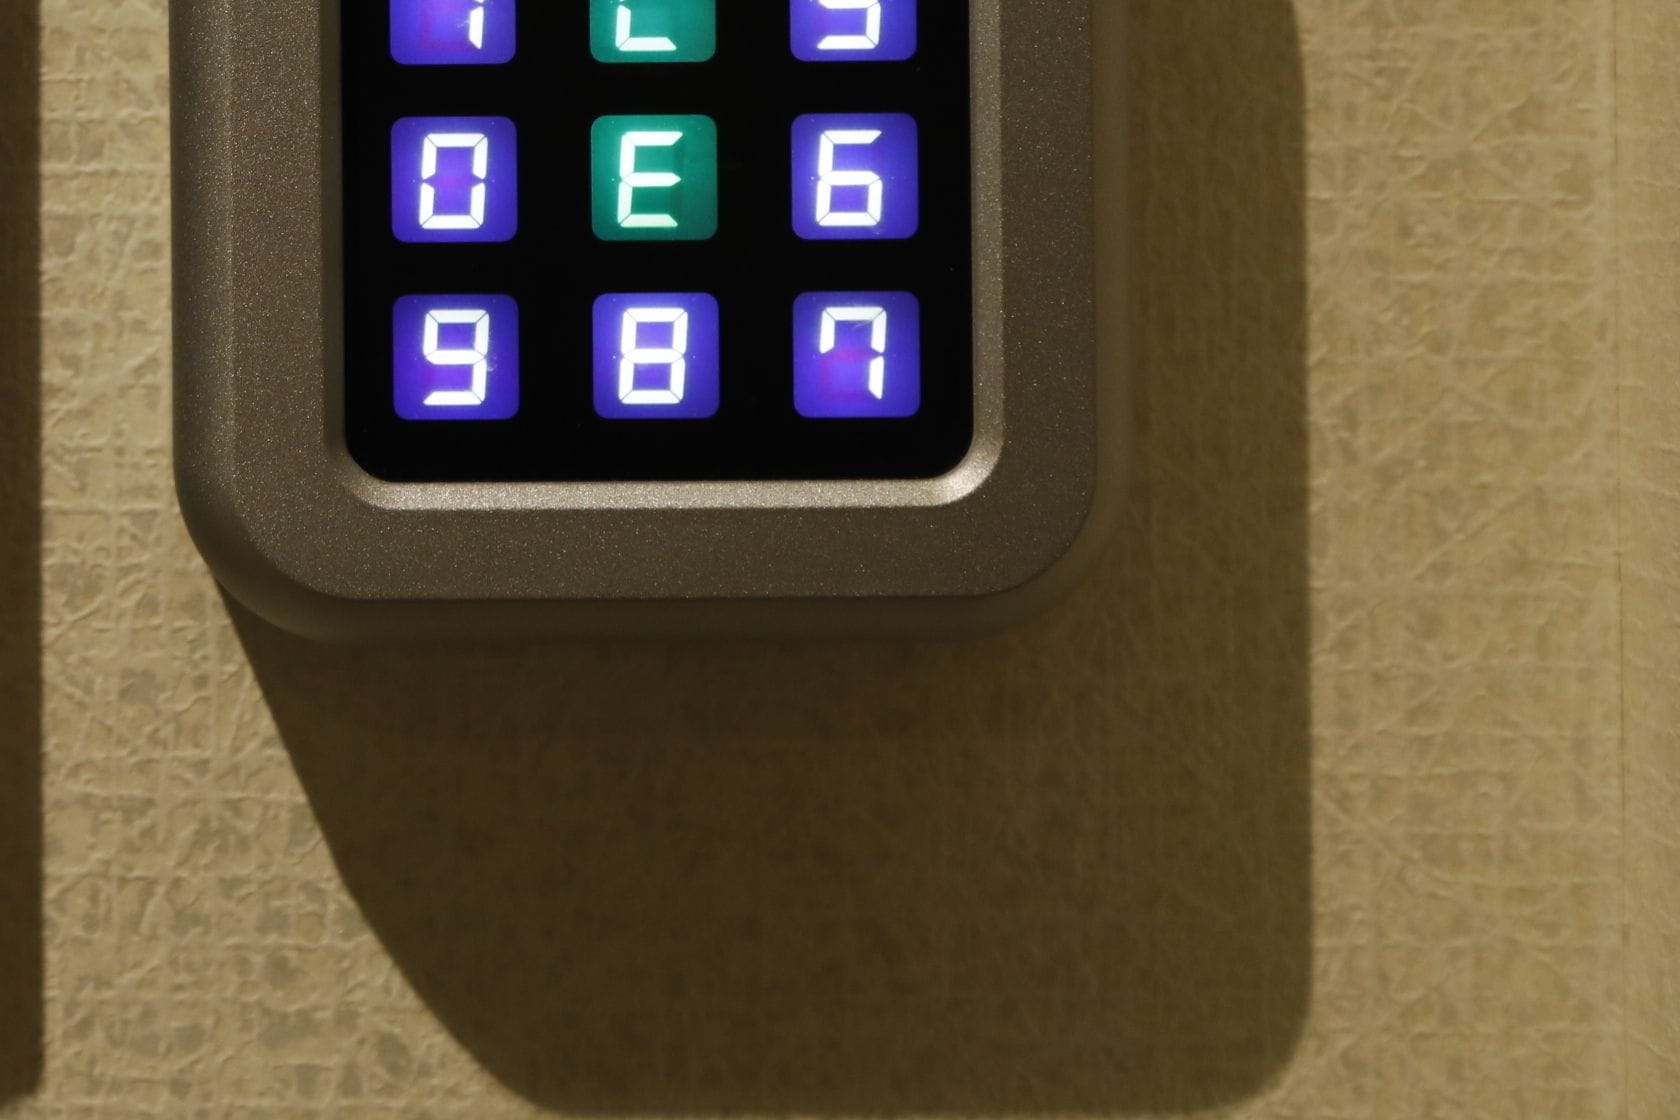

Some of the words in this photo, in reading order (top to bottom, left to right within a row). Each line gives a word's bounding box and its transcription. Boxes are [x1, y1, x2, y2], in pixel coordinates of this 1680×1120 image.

[419, 133, 488, 229] 0
[618, 131, 682, 227] E
[812, 130, 882, 226] 6
[423, 310, 489, 405] 9
[619, 307, 688, 404] 8
[819, 307, 886, 398] 7
